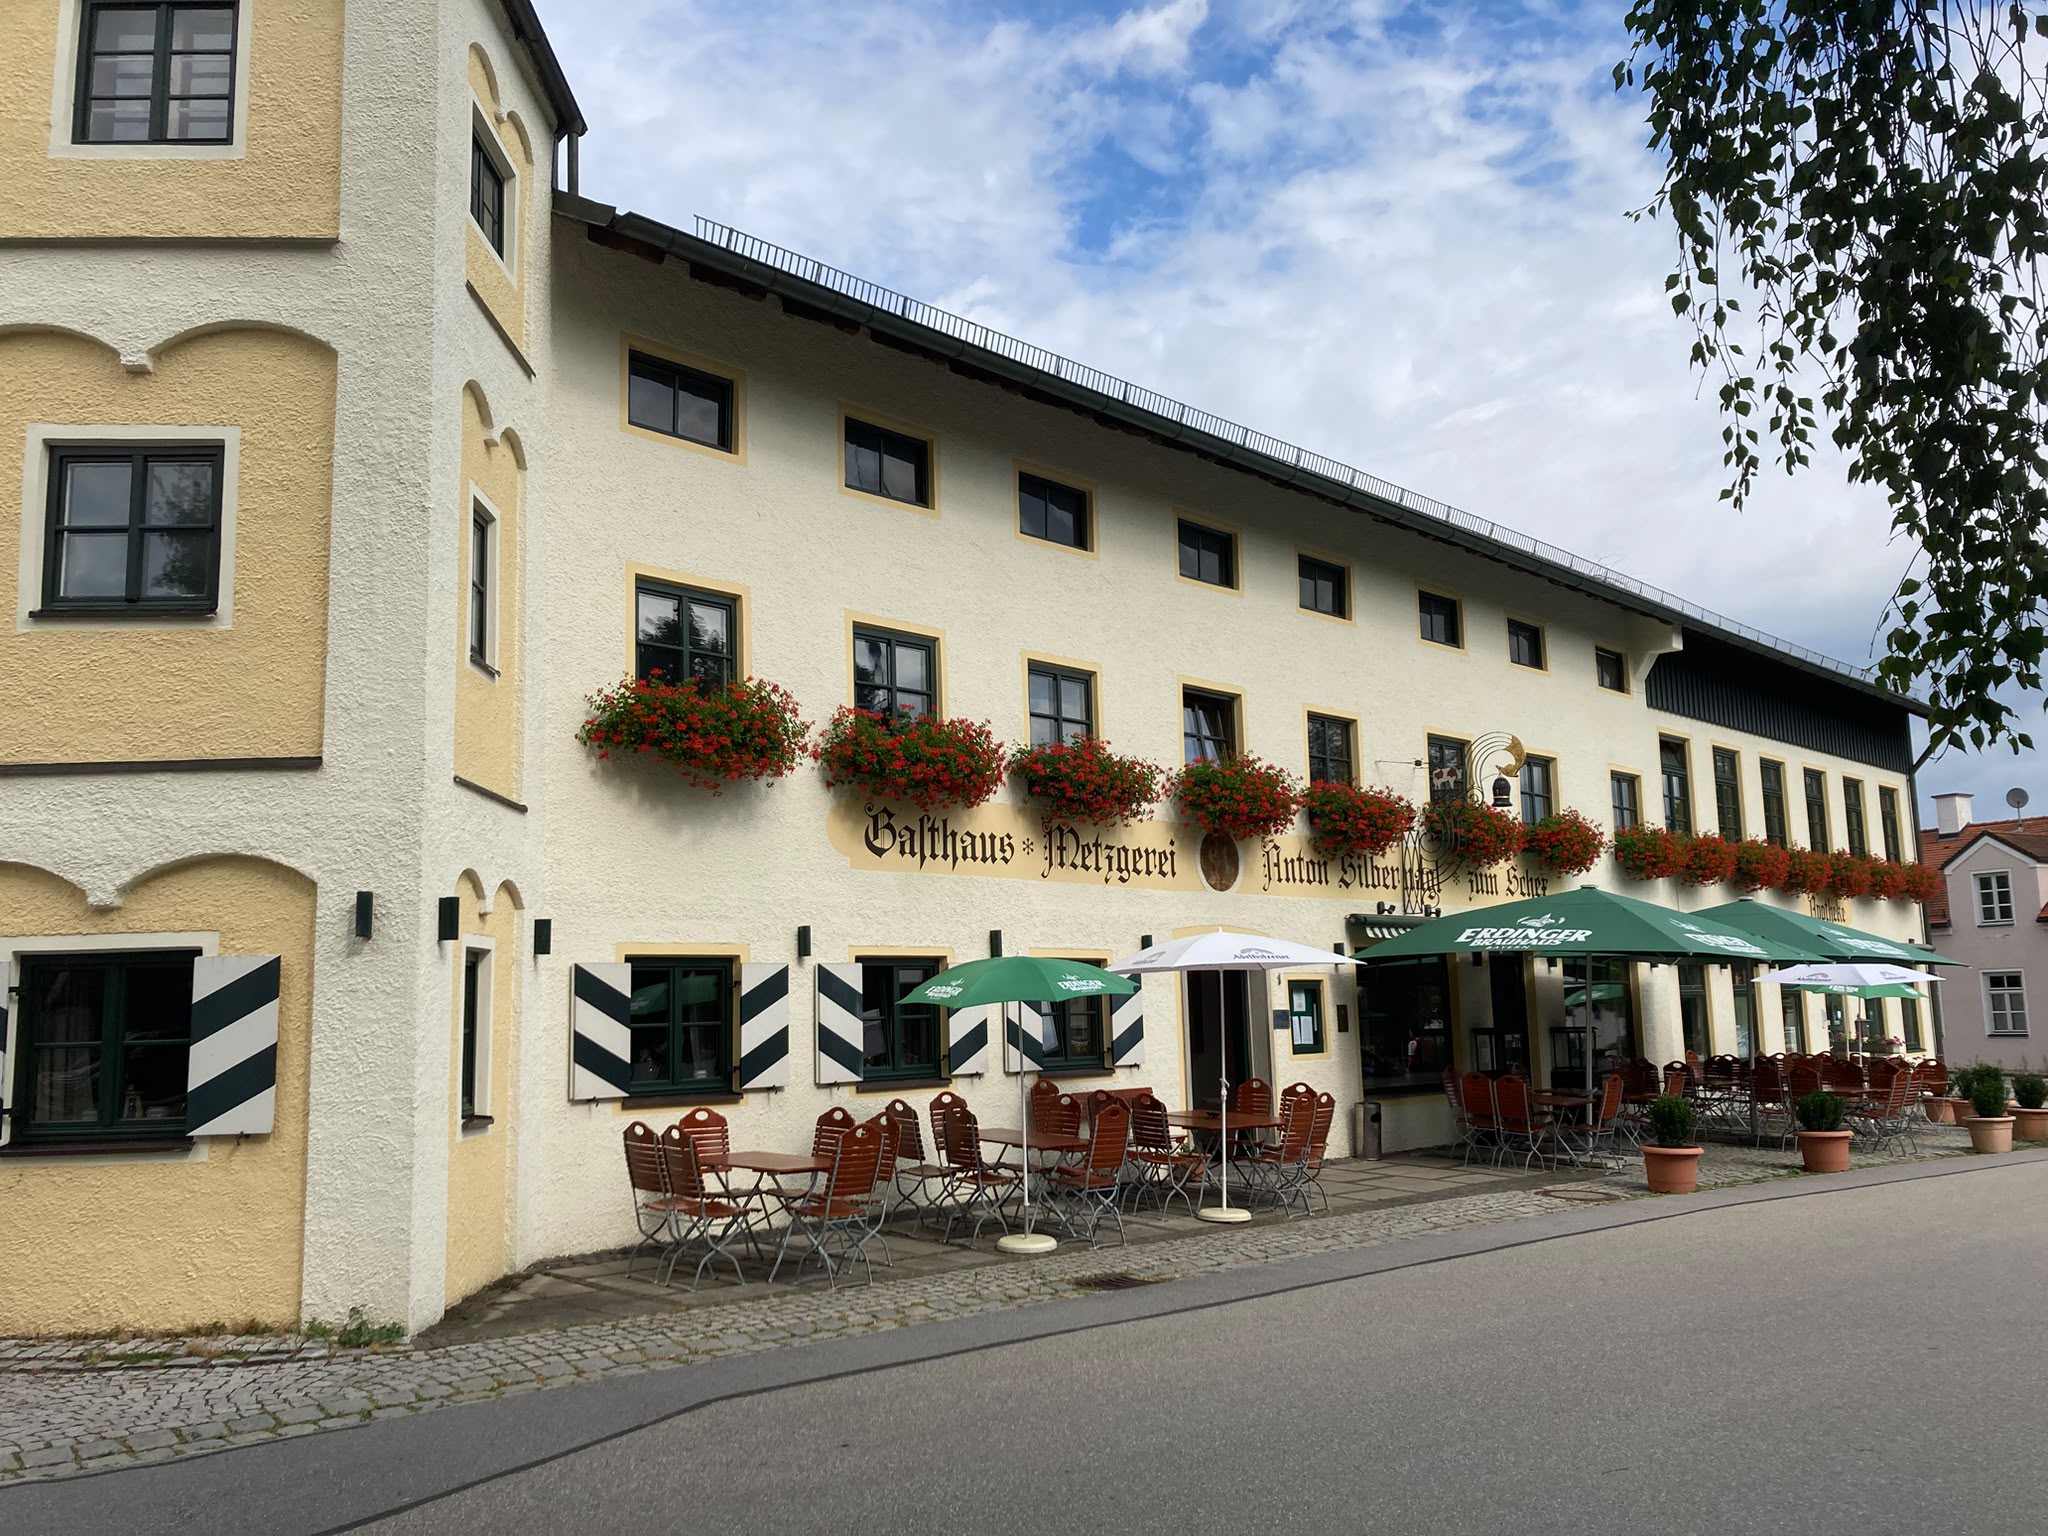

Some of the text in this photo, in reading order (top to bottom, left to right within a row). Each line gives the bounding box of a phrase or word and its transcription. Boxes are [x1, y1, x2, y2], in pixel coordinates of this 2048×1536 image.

[1041, 820, 1177, 884] Metzgerei
[1262, 837, 1329, 892] Anton
[1468, 870, 1499, 902] zum
[1454, 928, 1593, 942] ERDINGER
[1469, 938, 1562, 947] BRAUHAUS
